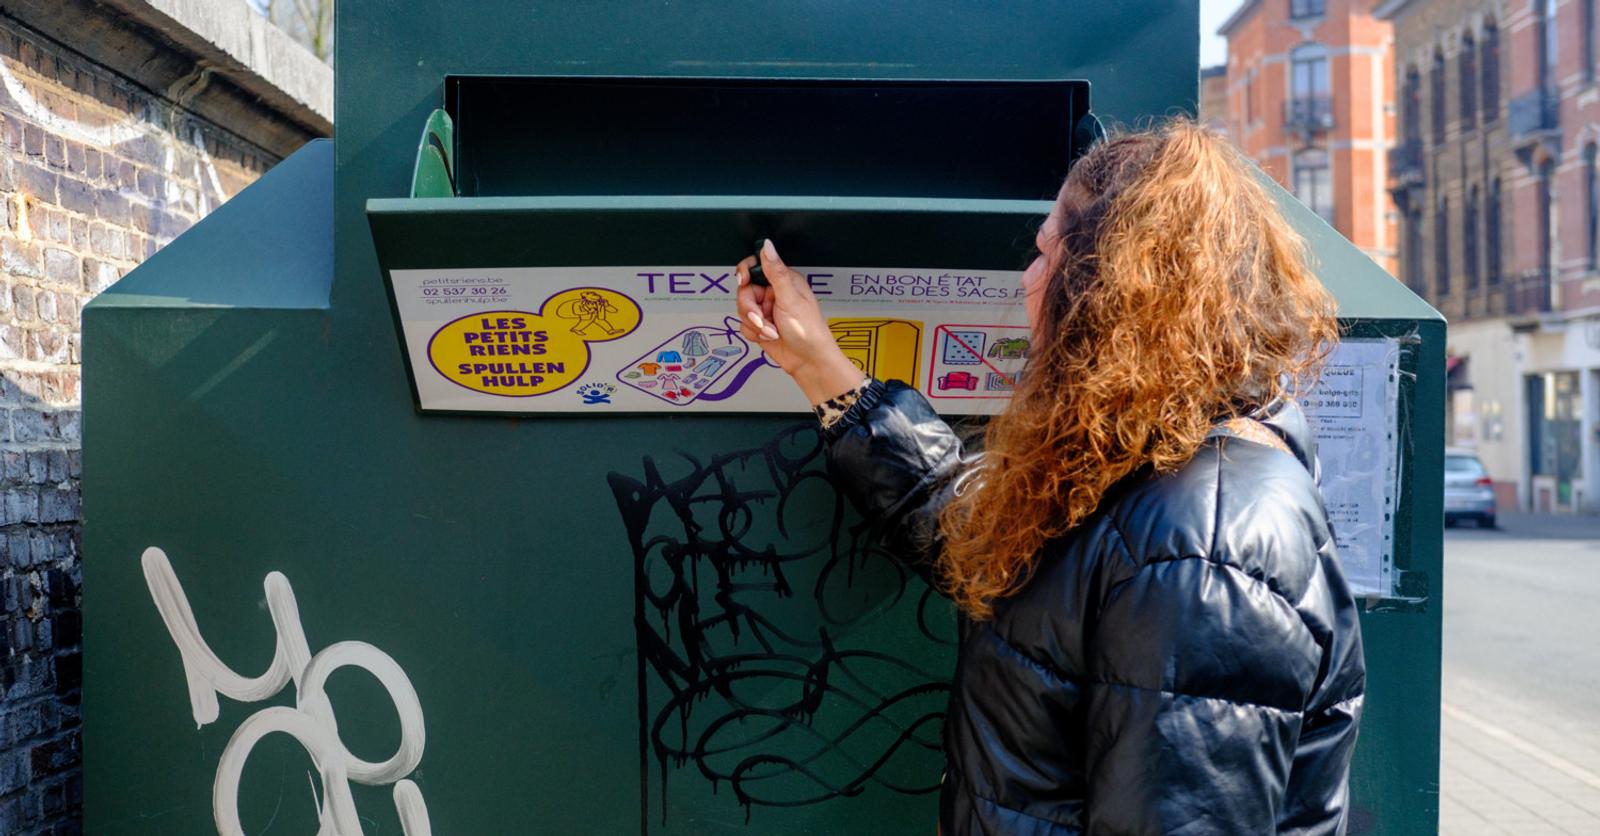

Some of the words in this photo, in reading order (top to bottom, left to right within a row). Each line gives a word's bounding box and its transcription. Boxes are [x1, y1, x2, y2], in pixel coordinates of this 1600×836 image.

[422, 276, 503, 286] petitsriens.be
[636, 273, 834, 294] TEXE
[850, 274, 880, 285] EN
[886, 275, 932, 286] BON
[937, 273, 987, 287] ÉTAT
[423, 287, 439, 296] 02
[443, 287, 466, 296] 537
[471, 287, 487, 295] 30
[492, 286, 507, 295] 26
[850, 285, 904, 296] DANS
[911, 286, 950, 297] DES
[958, 287, 1008, 298] SACS
[426, 296, 508, 305] spullenhulp.be
[482, 317, 527, 330] LES
[464, 330, 549, 344] PETITS
[469, 343, 547, 356] RIENS
[458, 362, 565, 375] SPULLEN
[482, 375, 545, 387] HULP
